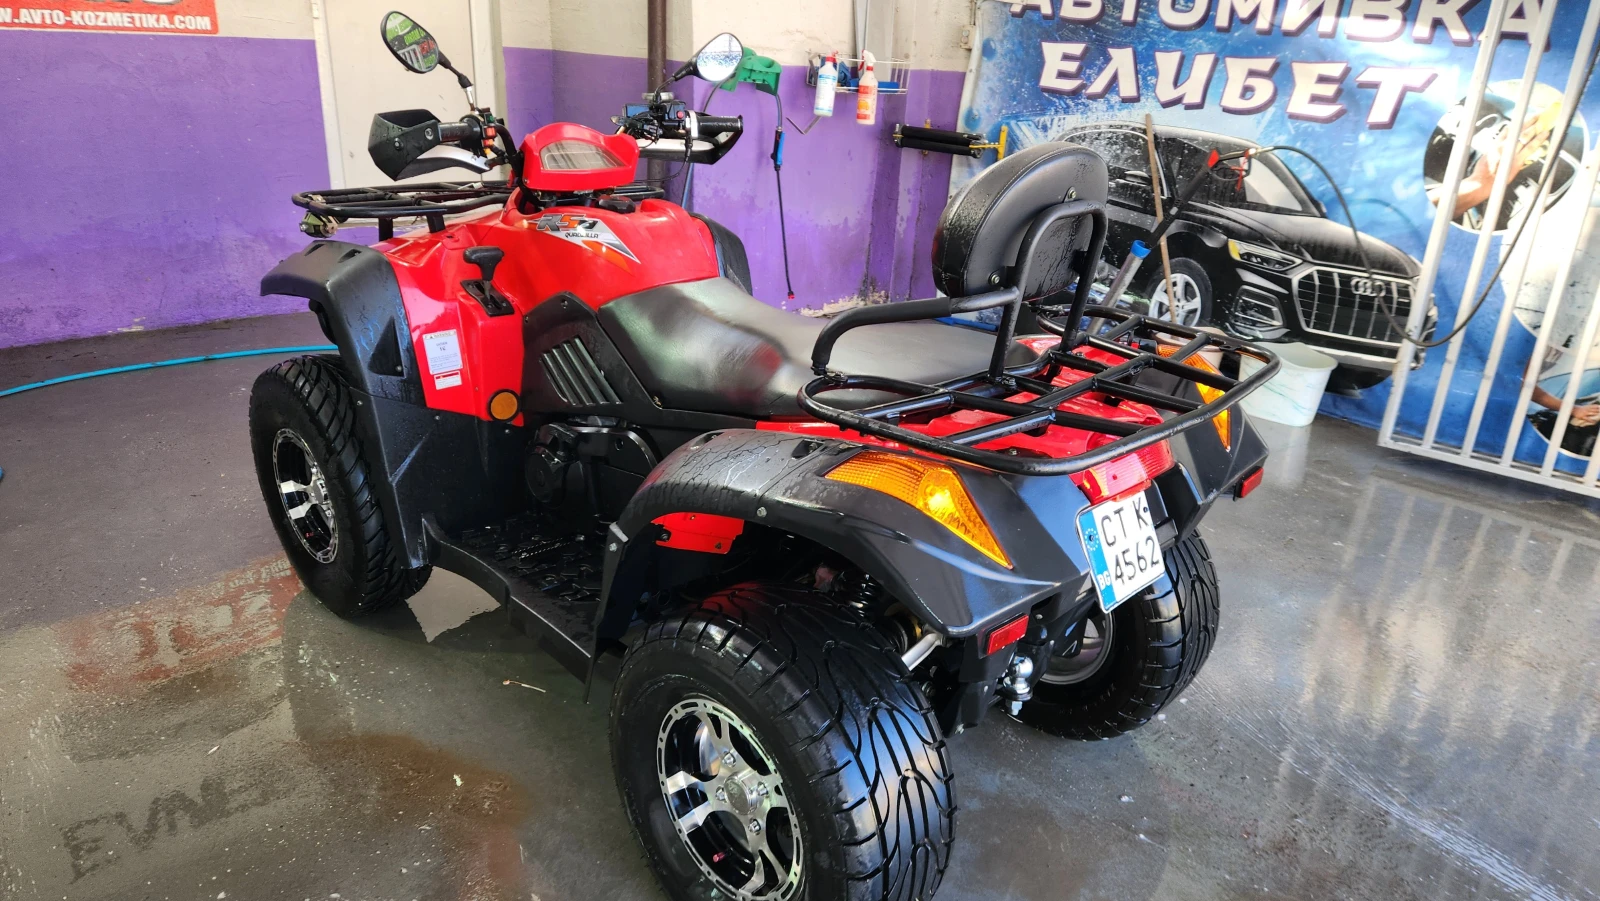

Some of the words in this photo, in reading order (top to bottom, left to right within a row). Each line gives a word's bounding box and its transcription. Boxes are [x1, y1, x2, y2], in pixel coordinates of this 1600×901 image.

[1039, 41, 1438, 129] ЕЛИБЕТ
[1100, 506, 1127, 548] CT
[1132, 496, 1150, 530] K
[1097, 570, 1111, 590] BG
[1114, 535, 1160, 585] 4562
